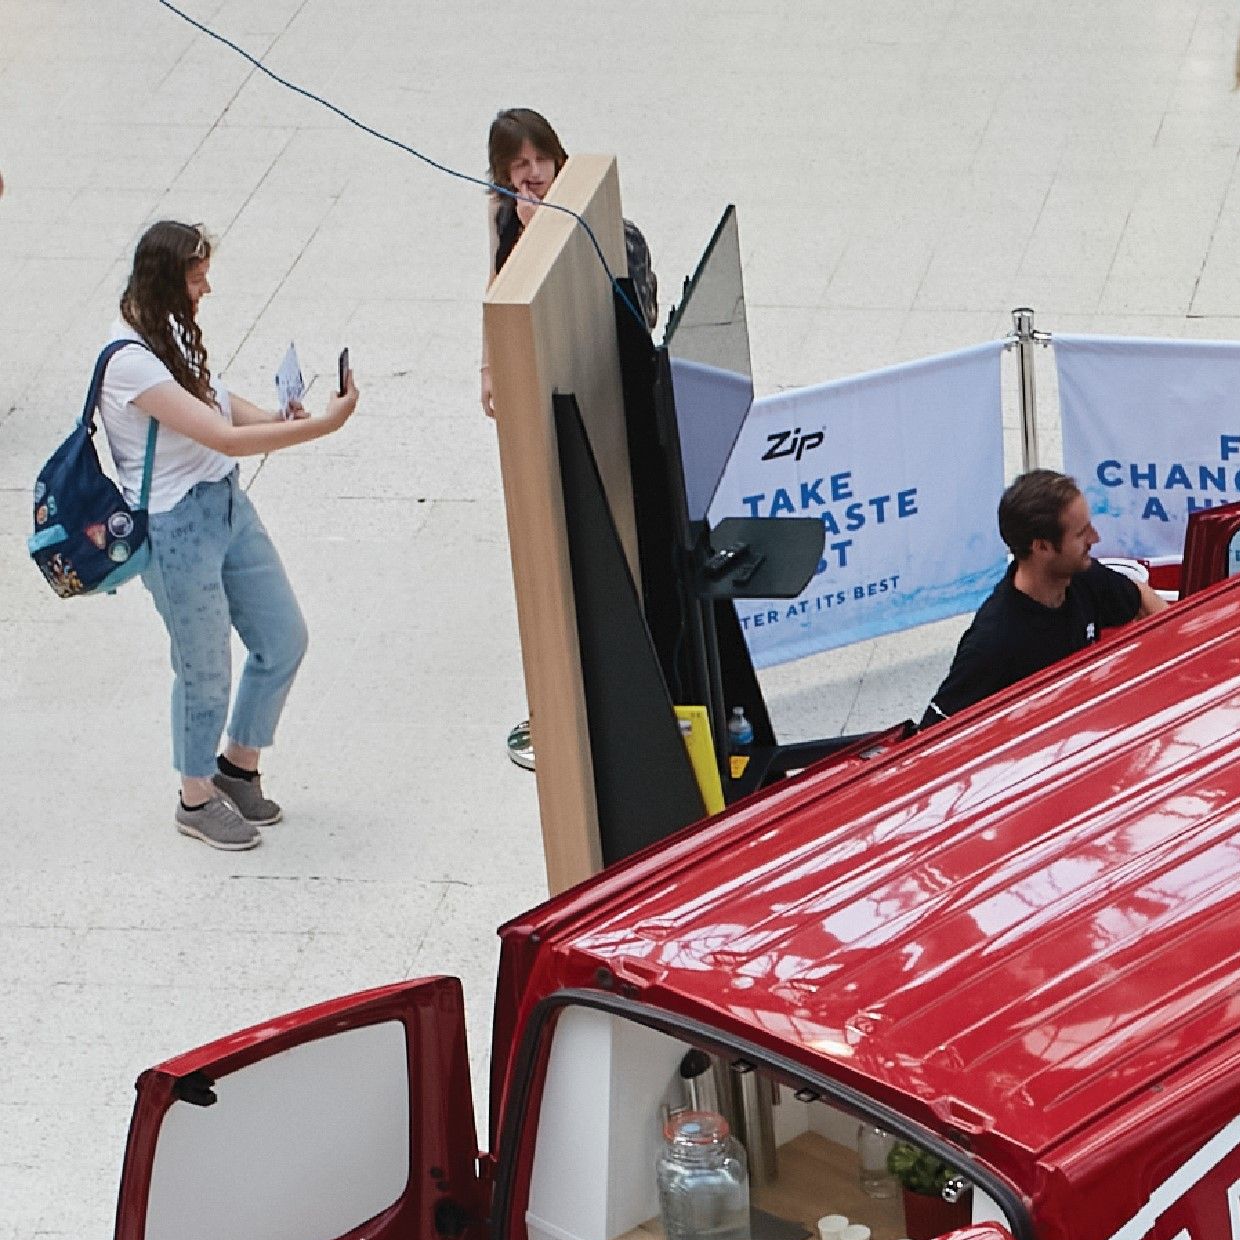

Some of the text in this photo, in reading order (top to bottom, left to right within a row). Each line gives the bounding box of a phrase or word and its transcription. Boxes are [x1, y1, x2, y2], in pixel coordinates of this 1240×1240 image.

[761, 428, 824, 461] Zip
[742, 471, 853, 519] TAKE
[819, 487, 919, 536] ASTE
[1140, 497, 1170, 522] A
[786, 600, 809, 619] AT
[816, 590, 846, 612] ITS
[853, 575, 900, 600] BEST
